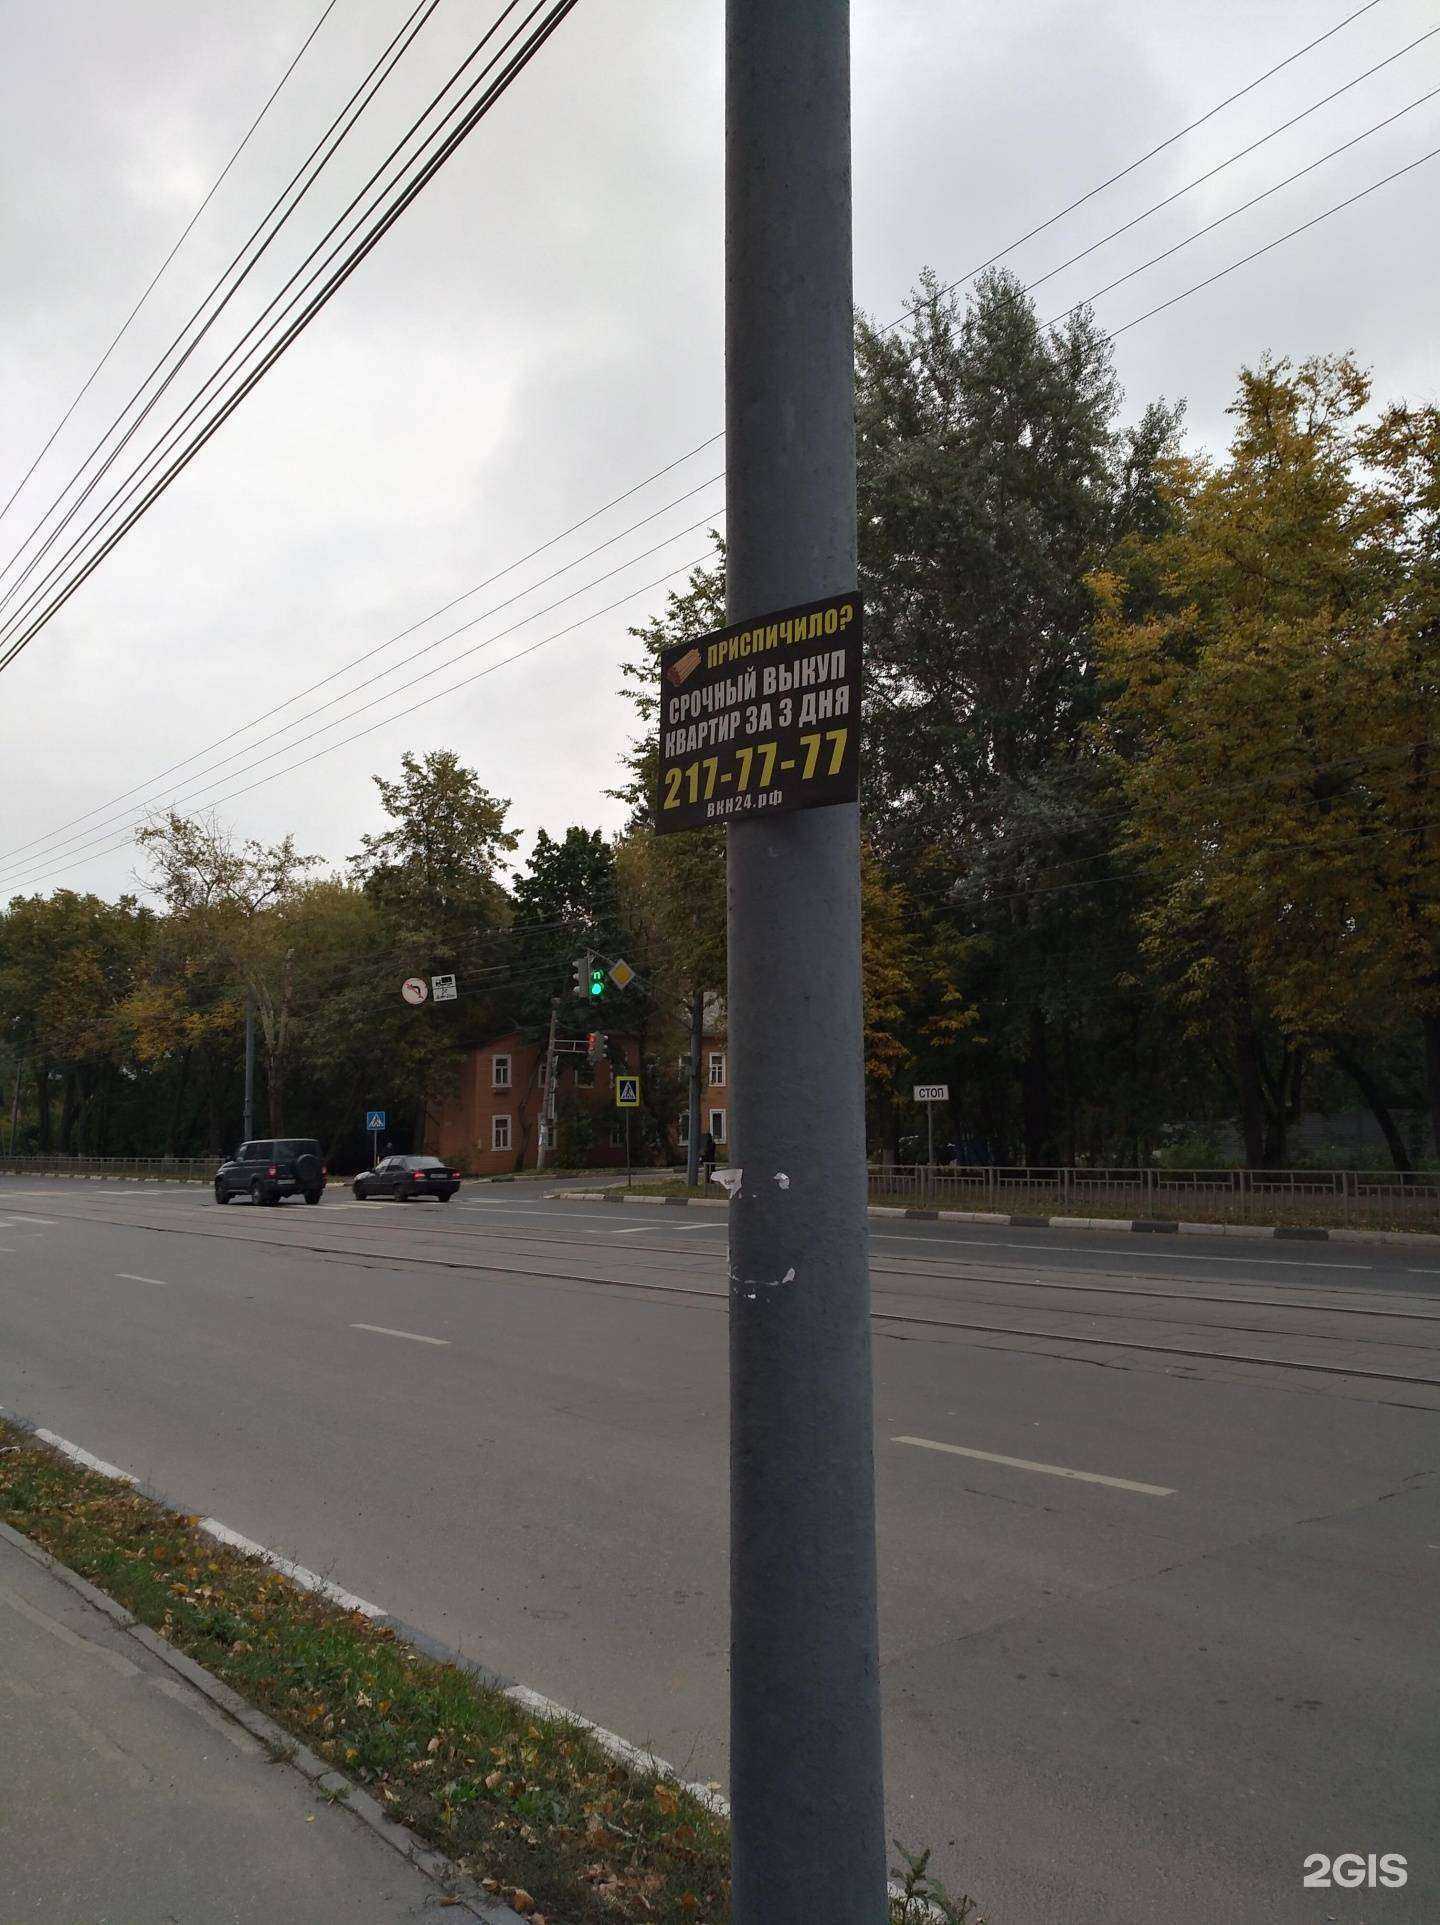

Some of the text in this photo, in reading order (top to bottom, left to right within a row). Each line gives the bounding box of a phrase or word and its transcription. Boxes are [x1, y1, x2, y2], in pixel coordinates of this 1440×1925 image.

[708, 604, 853, 668] ПРИСПИЧИЛО?
[665, 684, 850, 759] КВАРТИР ЗА 3 ДНЯ
[669, 649, 846, 725] СРОЧНЫЙ ВЫКУП
[664, 728, 848, 810] 217-77-77
[918, 1087, 944, 1098] СТОП
